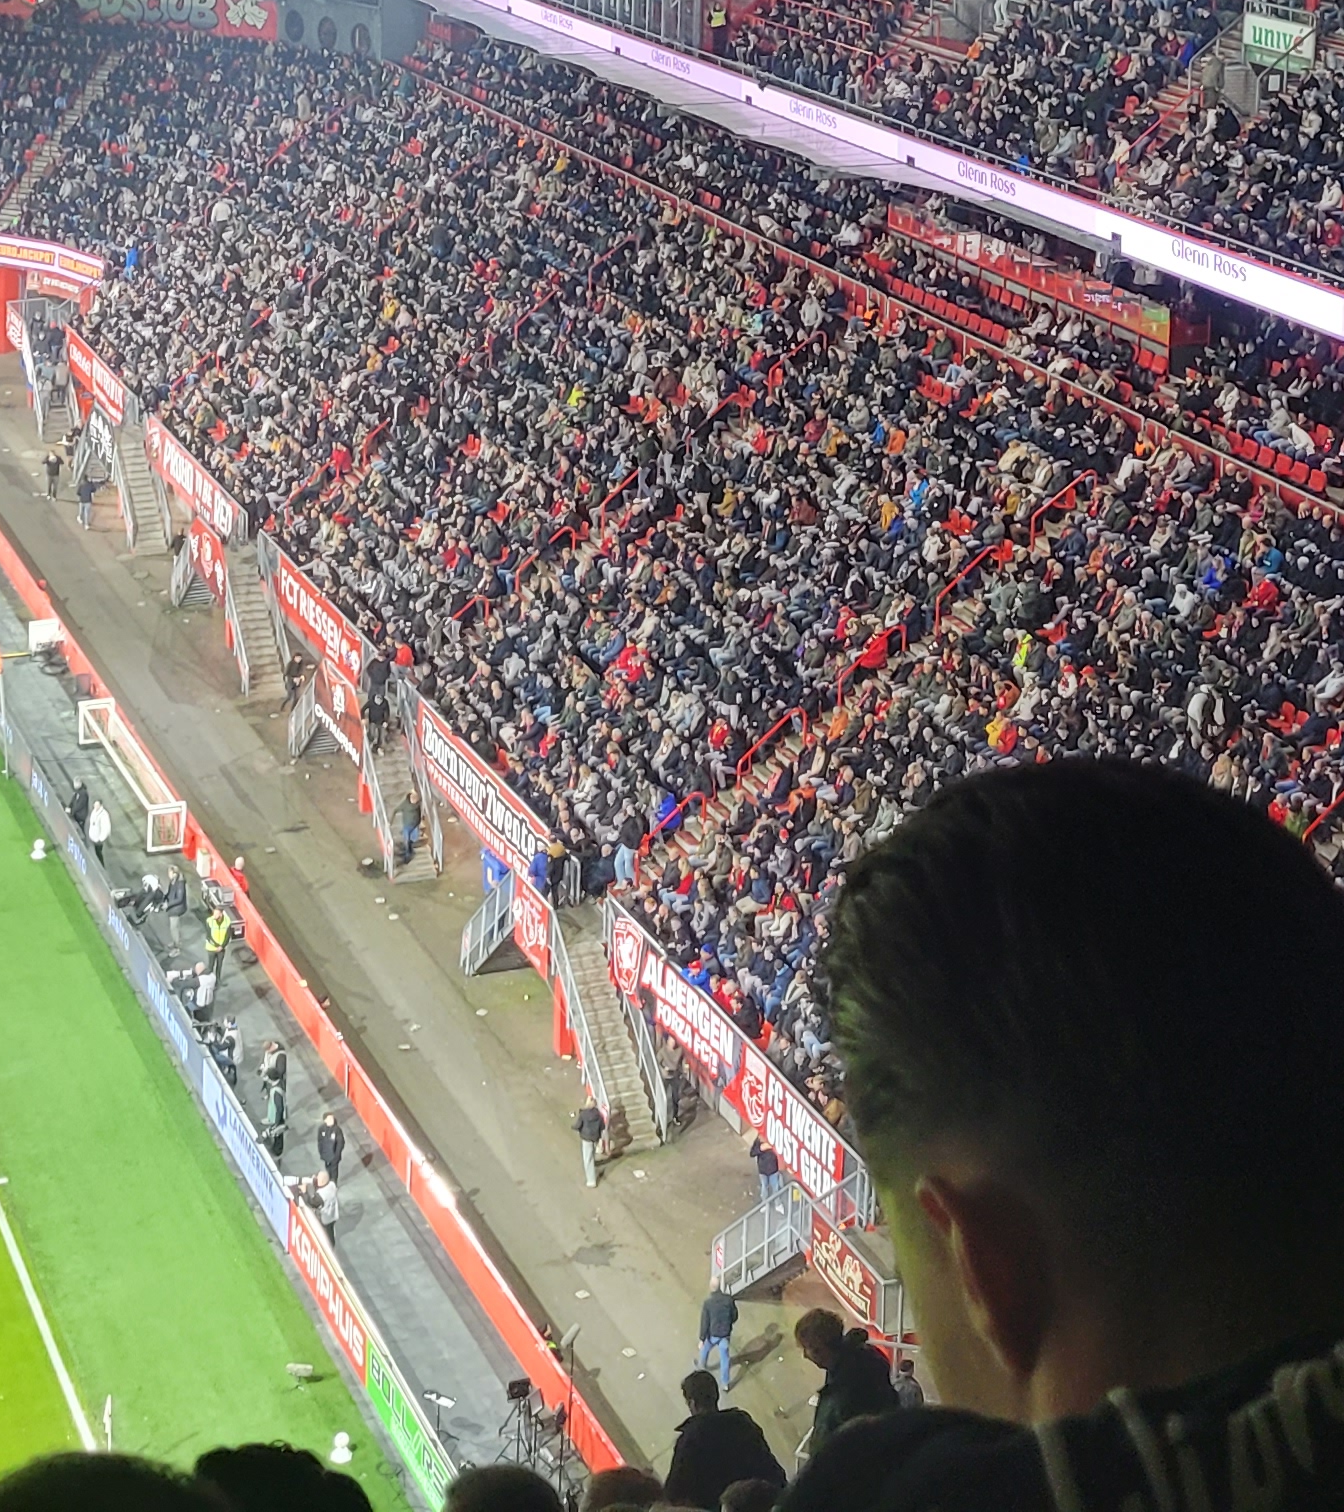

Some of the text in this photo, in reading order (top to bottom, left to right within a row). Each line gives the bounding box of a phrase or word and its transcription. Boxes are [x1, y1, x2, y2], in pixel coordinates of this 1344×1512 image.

[651, 48, 690, 74] Glenn Ross
[789, 98, 838, 129] Glenn Ross
[957, 160, 1017, 197] Glenn Ross
[1171, 238, 1248, 284] Glenn Ross
[163, 437, 194, 497] PROUD
[213, 490, 233, 537] RED
[485, 781, 536, 862] Twente
[642, 952, 734, 1066] ALBERGEN
[656, 997, 693, 1049] FORZA
[228, 1106, 275, 1197] LAMMERINK
[766, 1109, 799, 1174] OOST
[767, 1072, 837, 1175] FC TWENTE
[291, 1214, 365, 1368] KAMPHUIS
